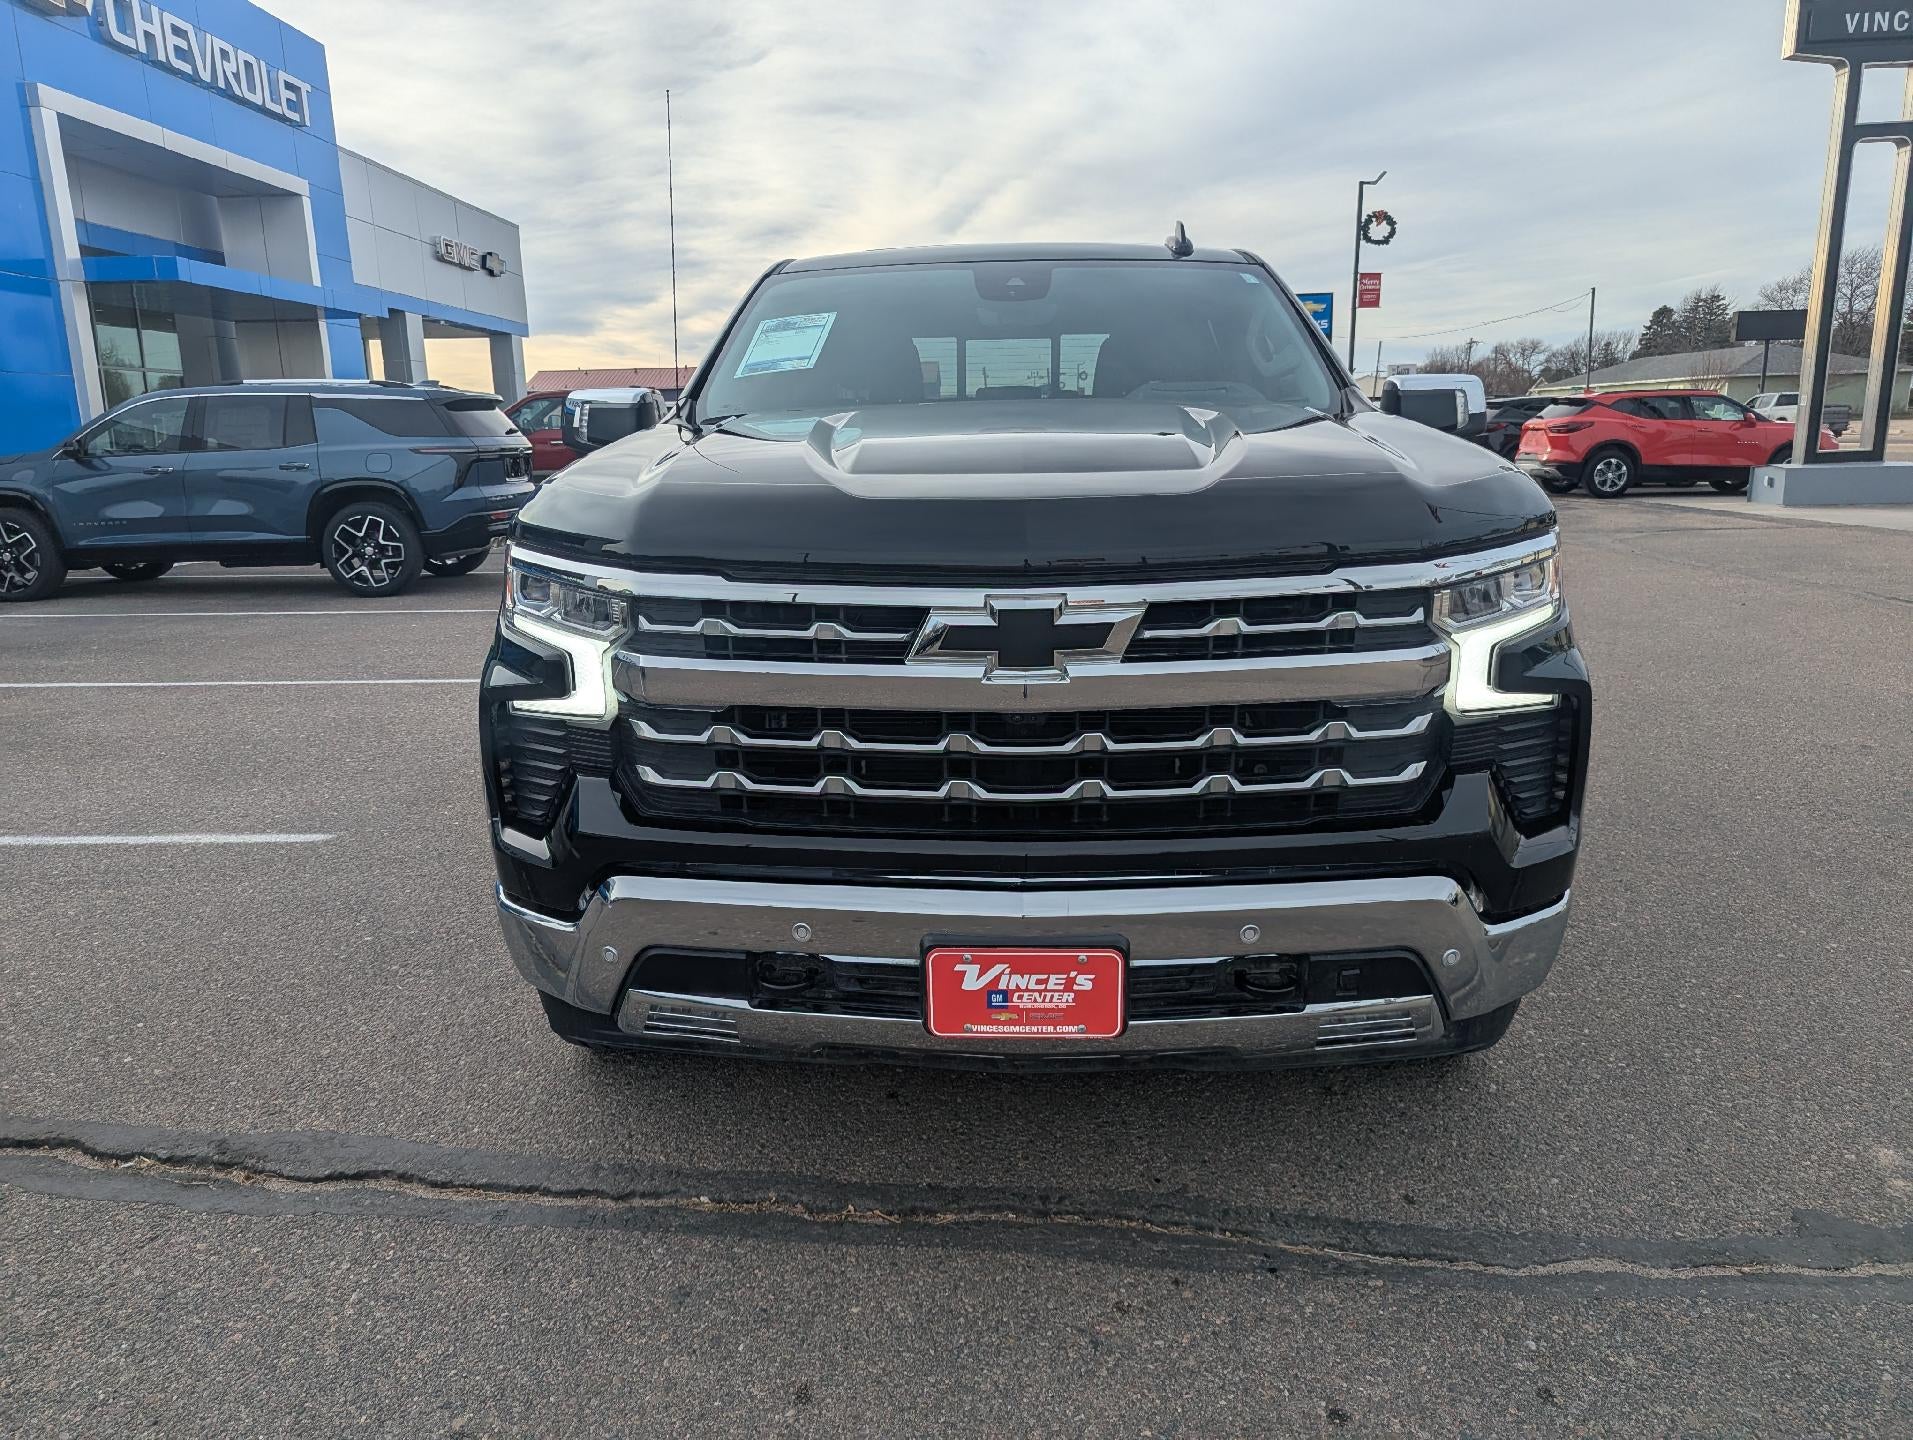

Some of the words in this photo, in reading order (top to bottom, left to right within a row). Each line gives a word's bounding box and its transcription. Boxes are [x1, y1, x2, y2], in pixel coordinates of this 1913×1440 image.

[1845, 10, 1910, 34] VINC
[104, 0, 311, 127] CHEVROLET
[440, 235, 481, 271] GMC
[954, 964, 1096, 991] VINCE'S
[991, 994, 1003, 1003] GM
[1012, 992, 1075, 1003] CENTER
[972, 1024, 1079, 1033] VINCESGMCENTER.COM
